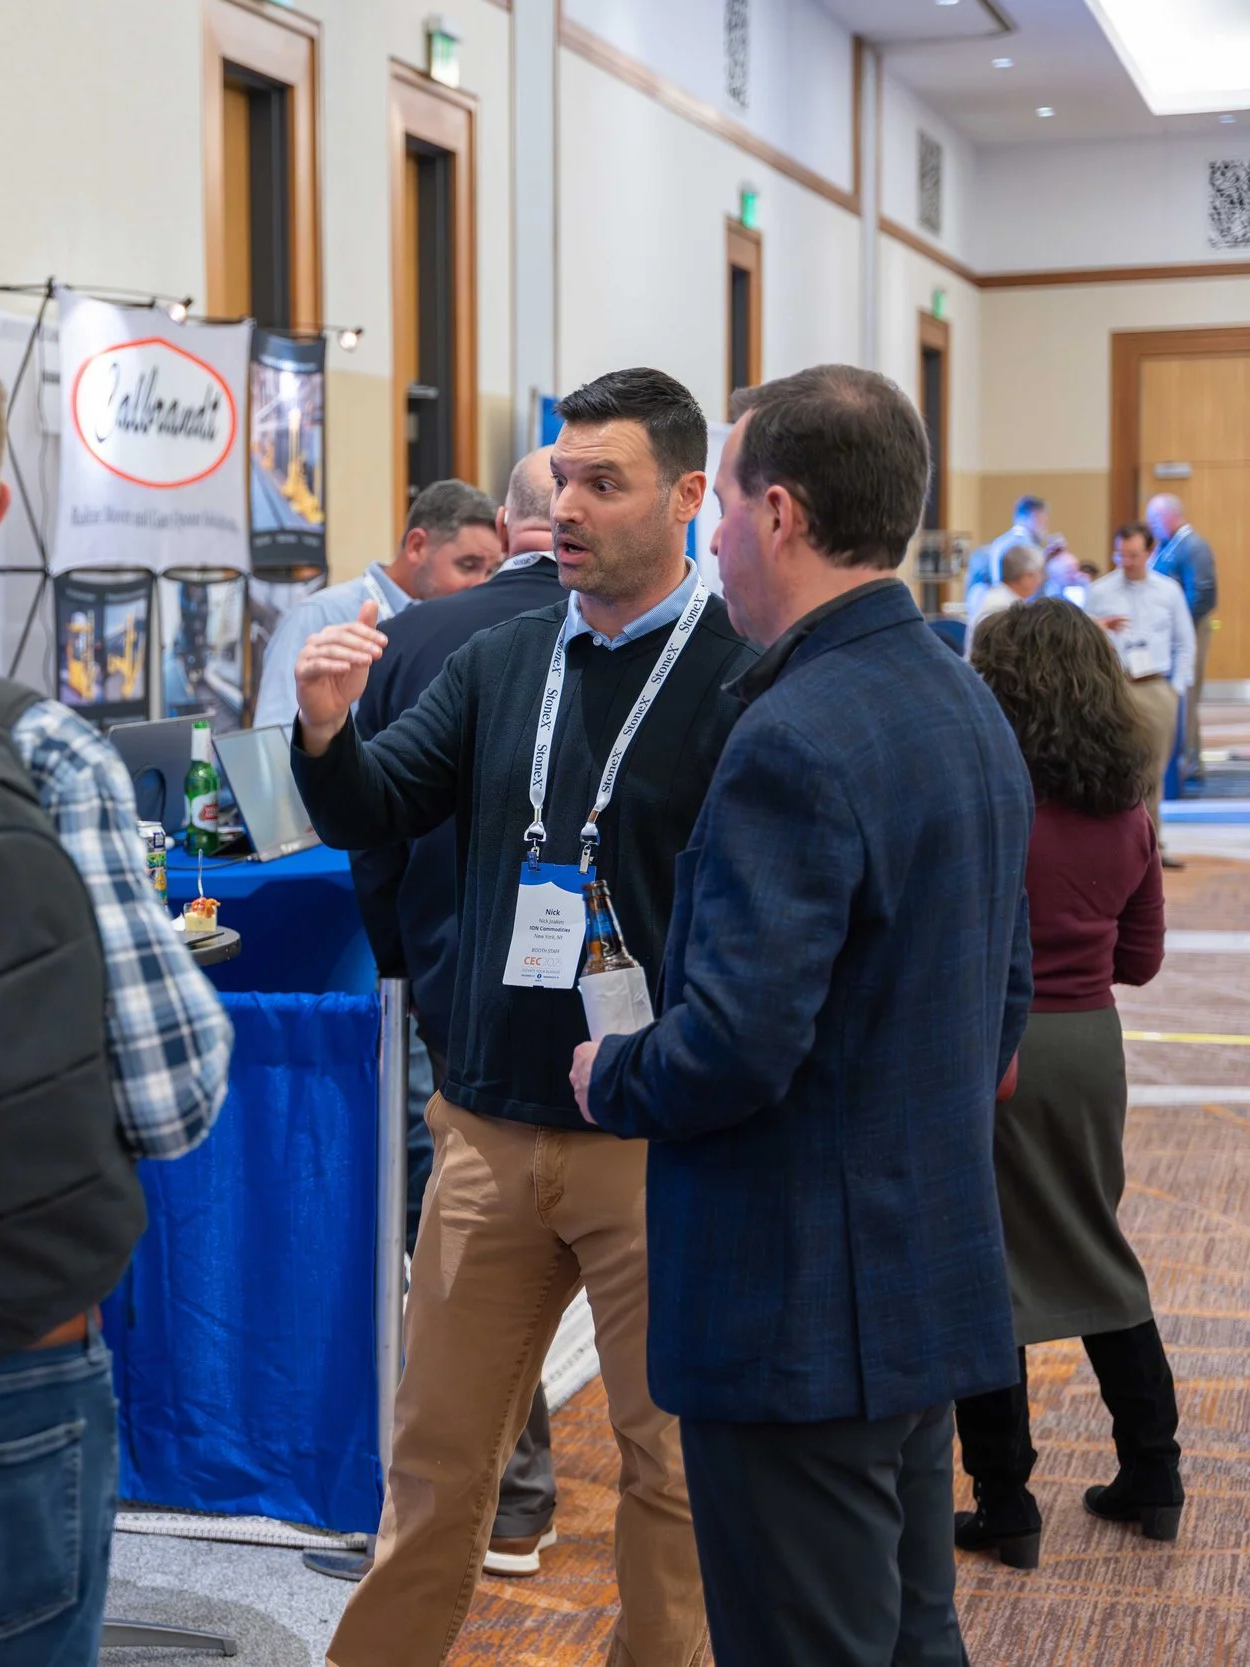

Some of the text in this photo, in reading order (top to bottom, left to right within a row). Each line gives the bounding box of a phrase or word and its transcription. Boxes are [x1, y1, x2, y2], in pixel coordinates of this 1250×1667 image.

[679, 592, 705, 634] StoneX
[651, 642, 680, 685] StoneX
[540, 687, 559, 731] StoneX
[623, 695, 651, 737] StoneX
[533, 743, 548, 789] StoneX
[602, 747, 623, 794] StoneX
[545, 908, 561, 916] Nick
